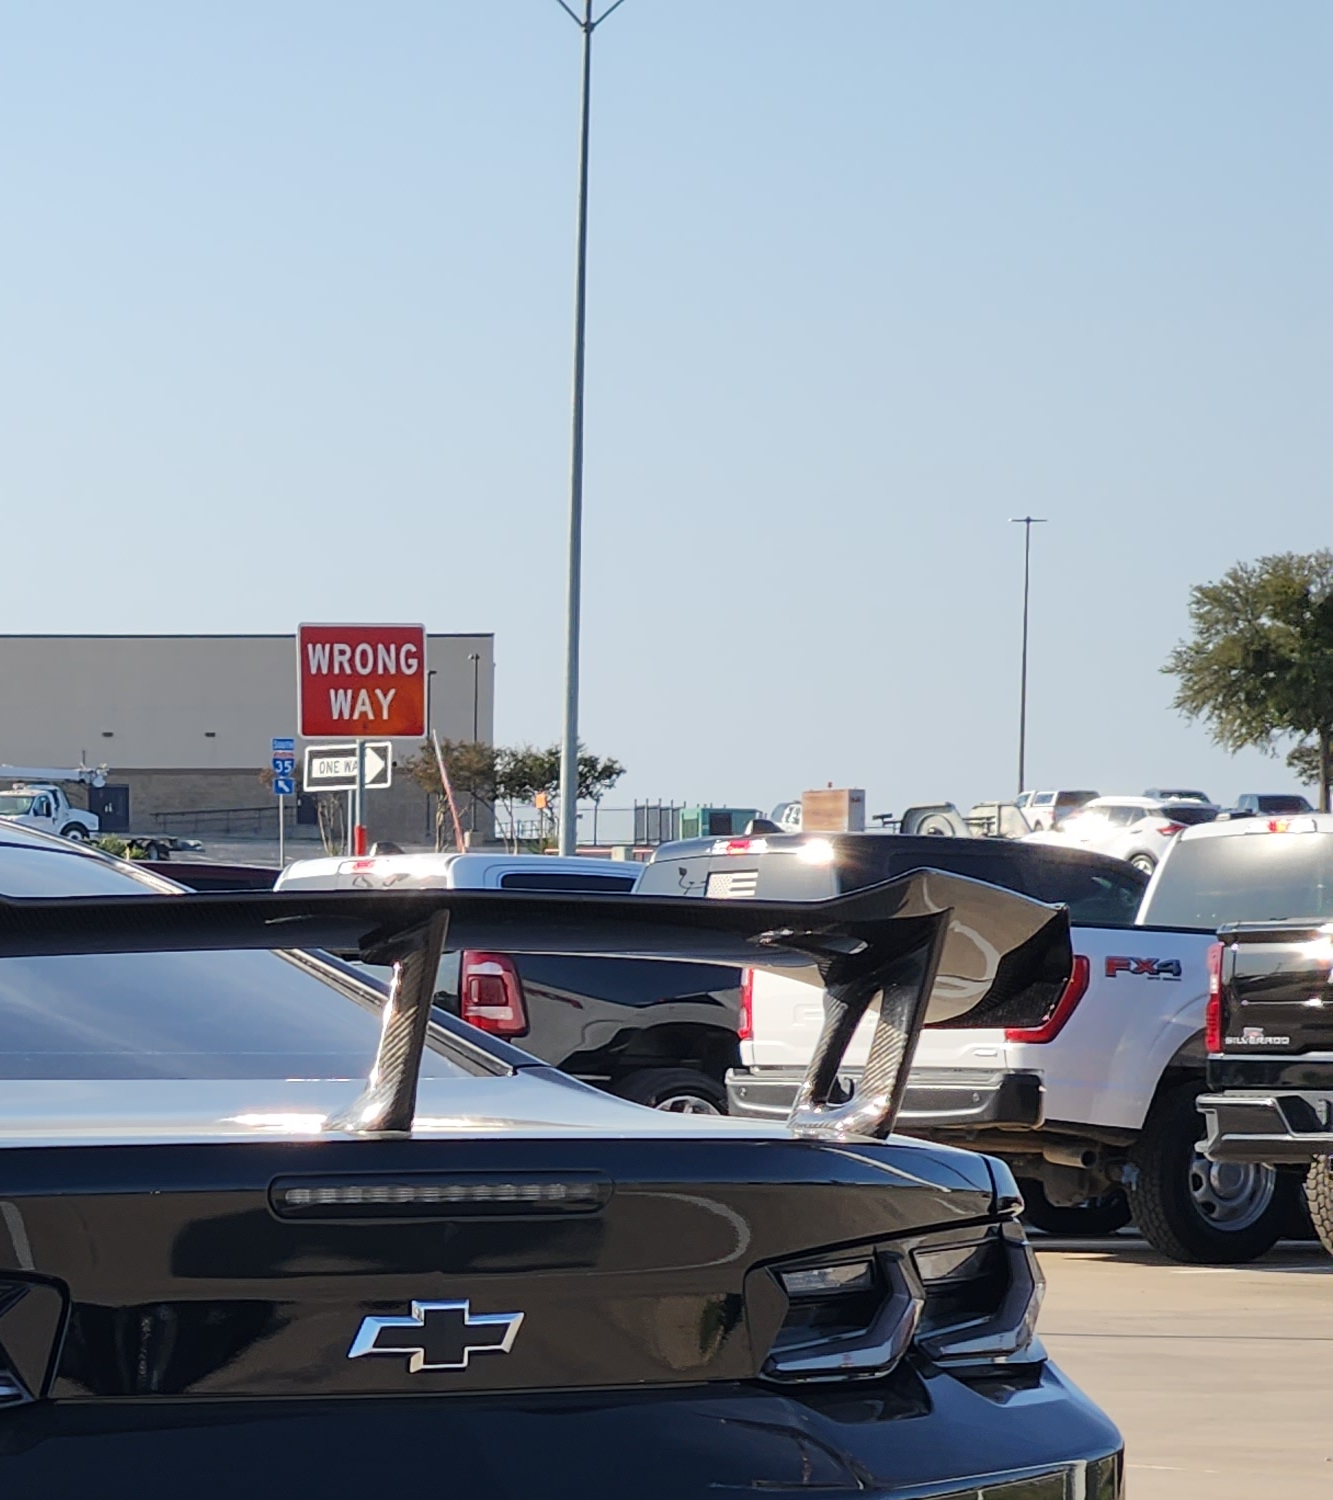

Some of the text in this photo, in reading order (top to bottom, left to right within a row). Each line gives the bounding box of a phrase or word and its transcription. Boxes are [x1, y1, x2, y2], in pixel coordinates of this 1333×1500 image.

[307, 643, 419, 676] WRONG
[330, 688, 396, 720] WAY
[275, 760, 292, 773] 35
[319, 760, 340, 774] ONE
[1105, 956, 1182, 977] FX4
[1225, 1036, 1290, 1045] SILVERADO
